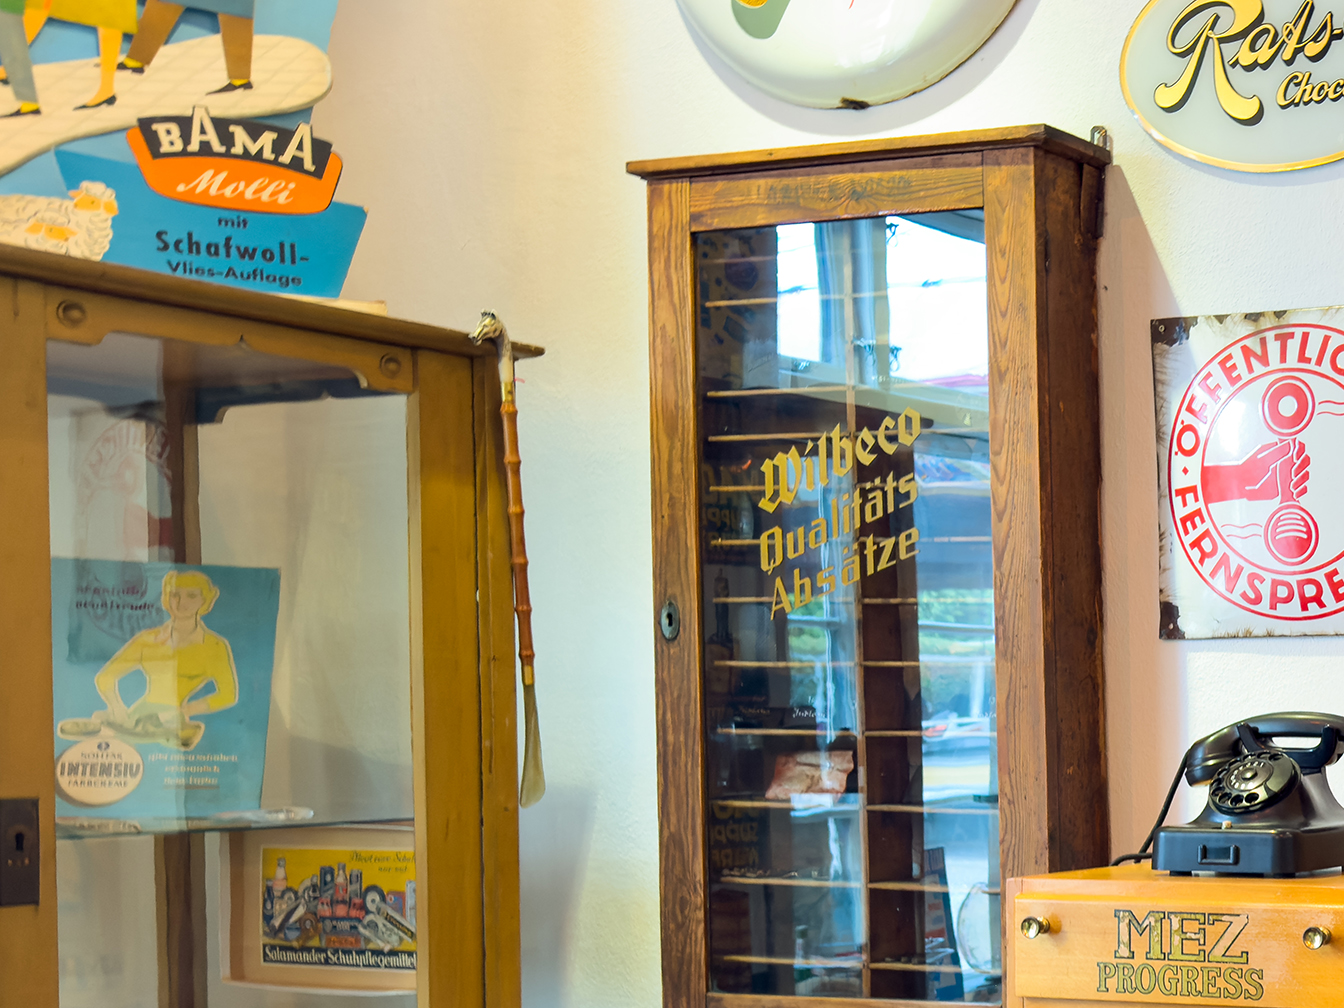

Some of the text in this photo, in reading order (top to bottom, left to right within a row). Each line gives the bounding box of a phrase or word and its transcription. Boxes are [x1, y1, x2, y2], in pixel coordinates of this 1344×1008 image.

[150, 105, 317, 172] BAMA
[176, 168, 297, 206] Molli
[217, 215, 249, 230] mit
[155, 230, 310, 267] Schafwoll-
[166, 259, 303, 288] Vlies-Auflage
[758, 406, 921, 514] Wilbeco
[759, 471, 918, 575] Qualitäts
[771, 527, 920, 621] Absätze
[59, 762, 140, 777] INTENSIV
[1114, 909, 1249, 964] MEZ
[265, 944, 416, 969] Salamander Schuhpflegemittel
[1097, 961, 1264, 1000] PROGRESS
